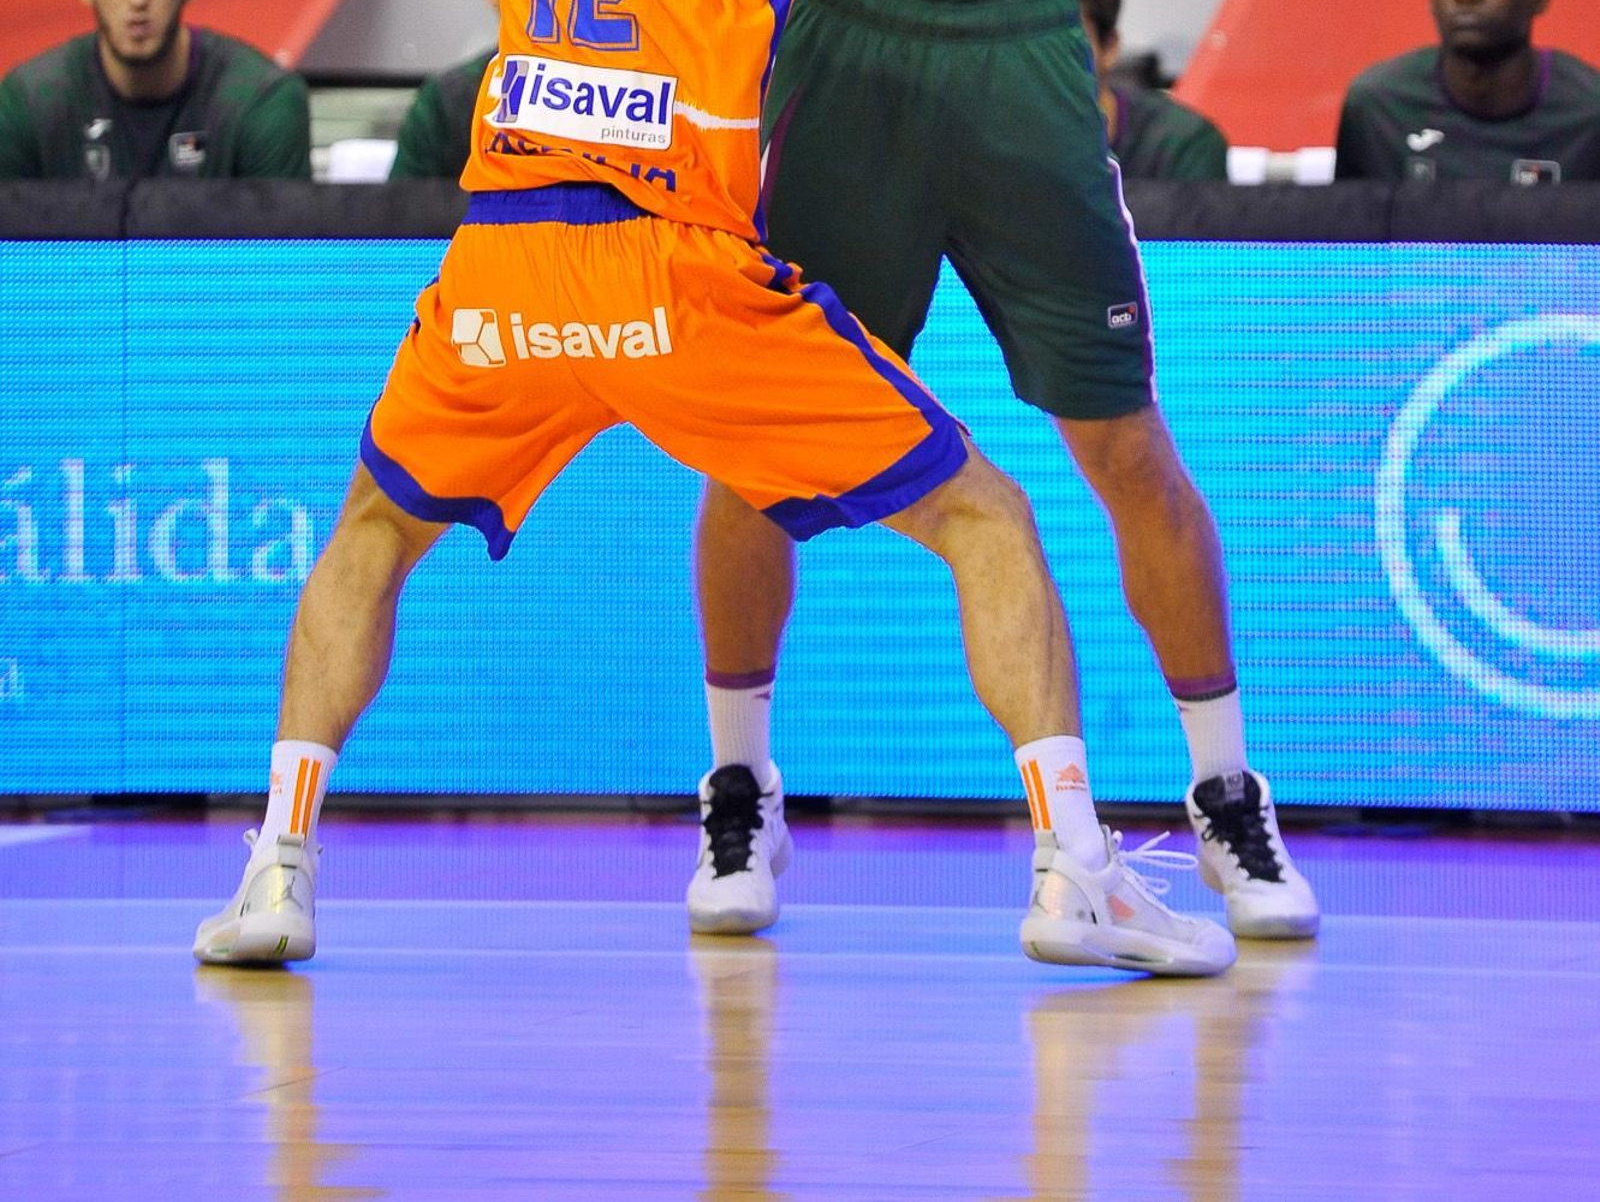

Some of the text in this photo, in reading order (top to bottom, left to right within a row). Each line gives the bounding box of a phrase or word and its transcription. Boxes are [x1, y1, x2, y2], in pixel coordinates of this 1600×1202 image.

[528, 63, 673, 126] isaval
[601, 125, 667, 144] pinturas
[509, 305, 673, 360] isaval
[1111, 311, 1132, 324] acb
